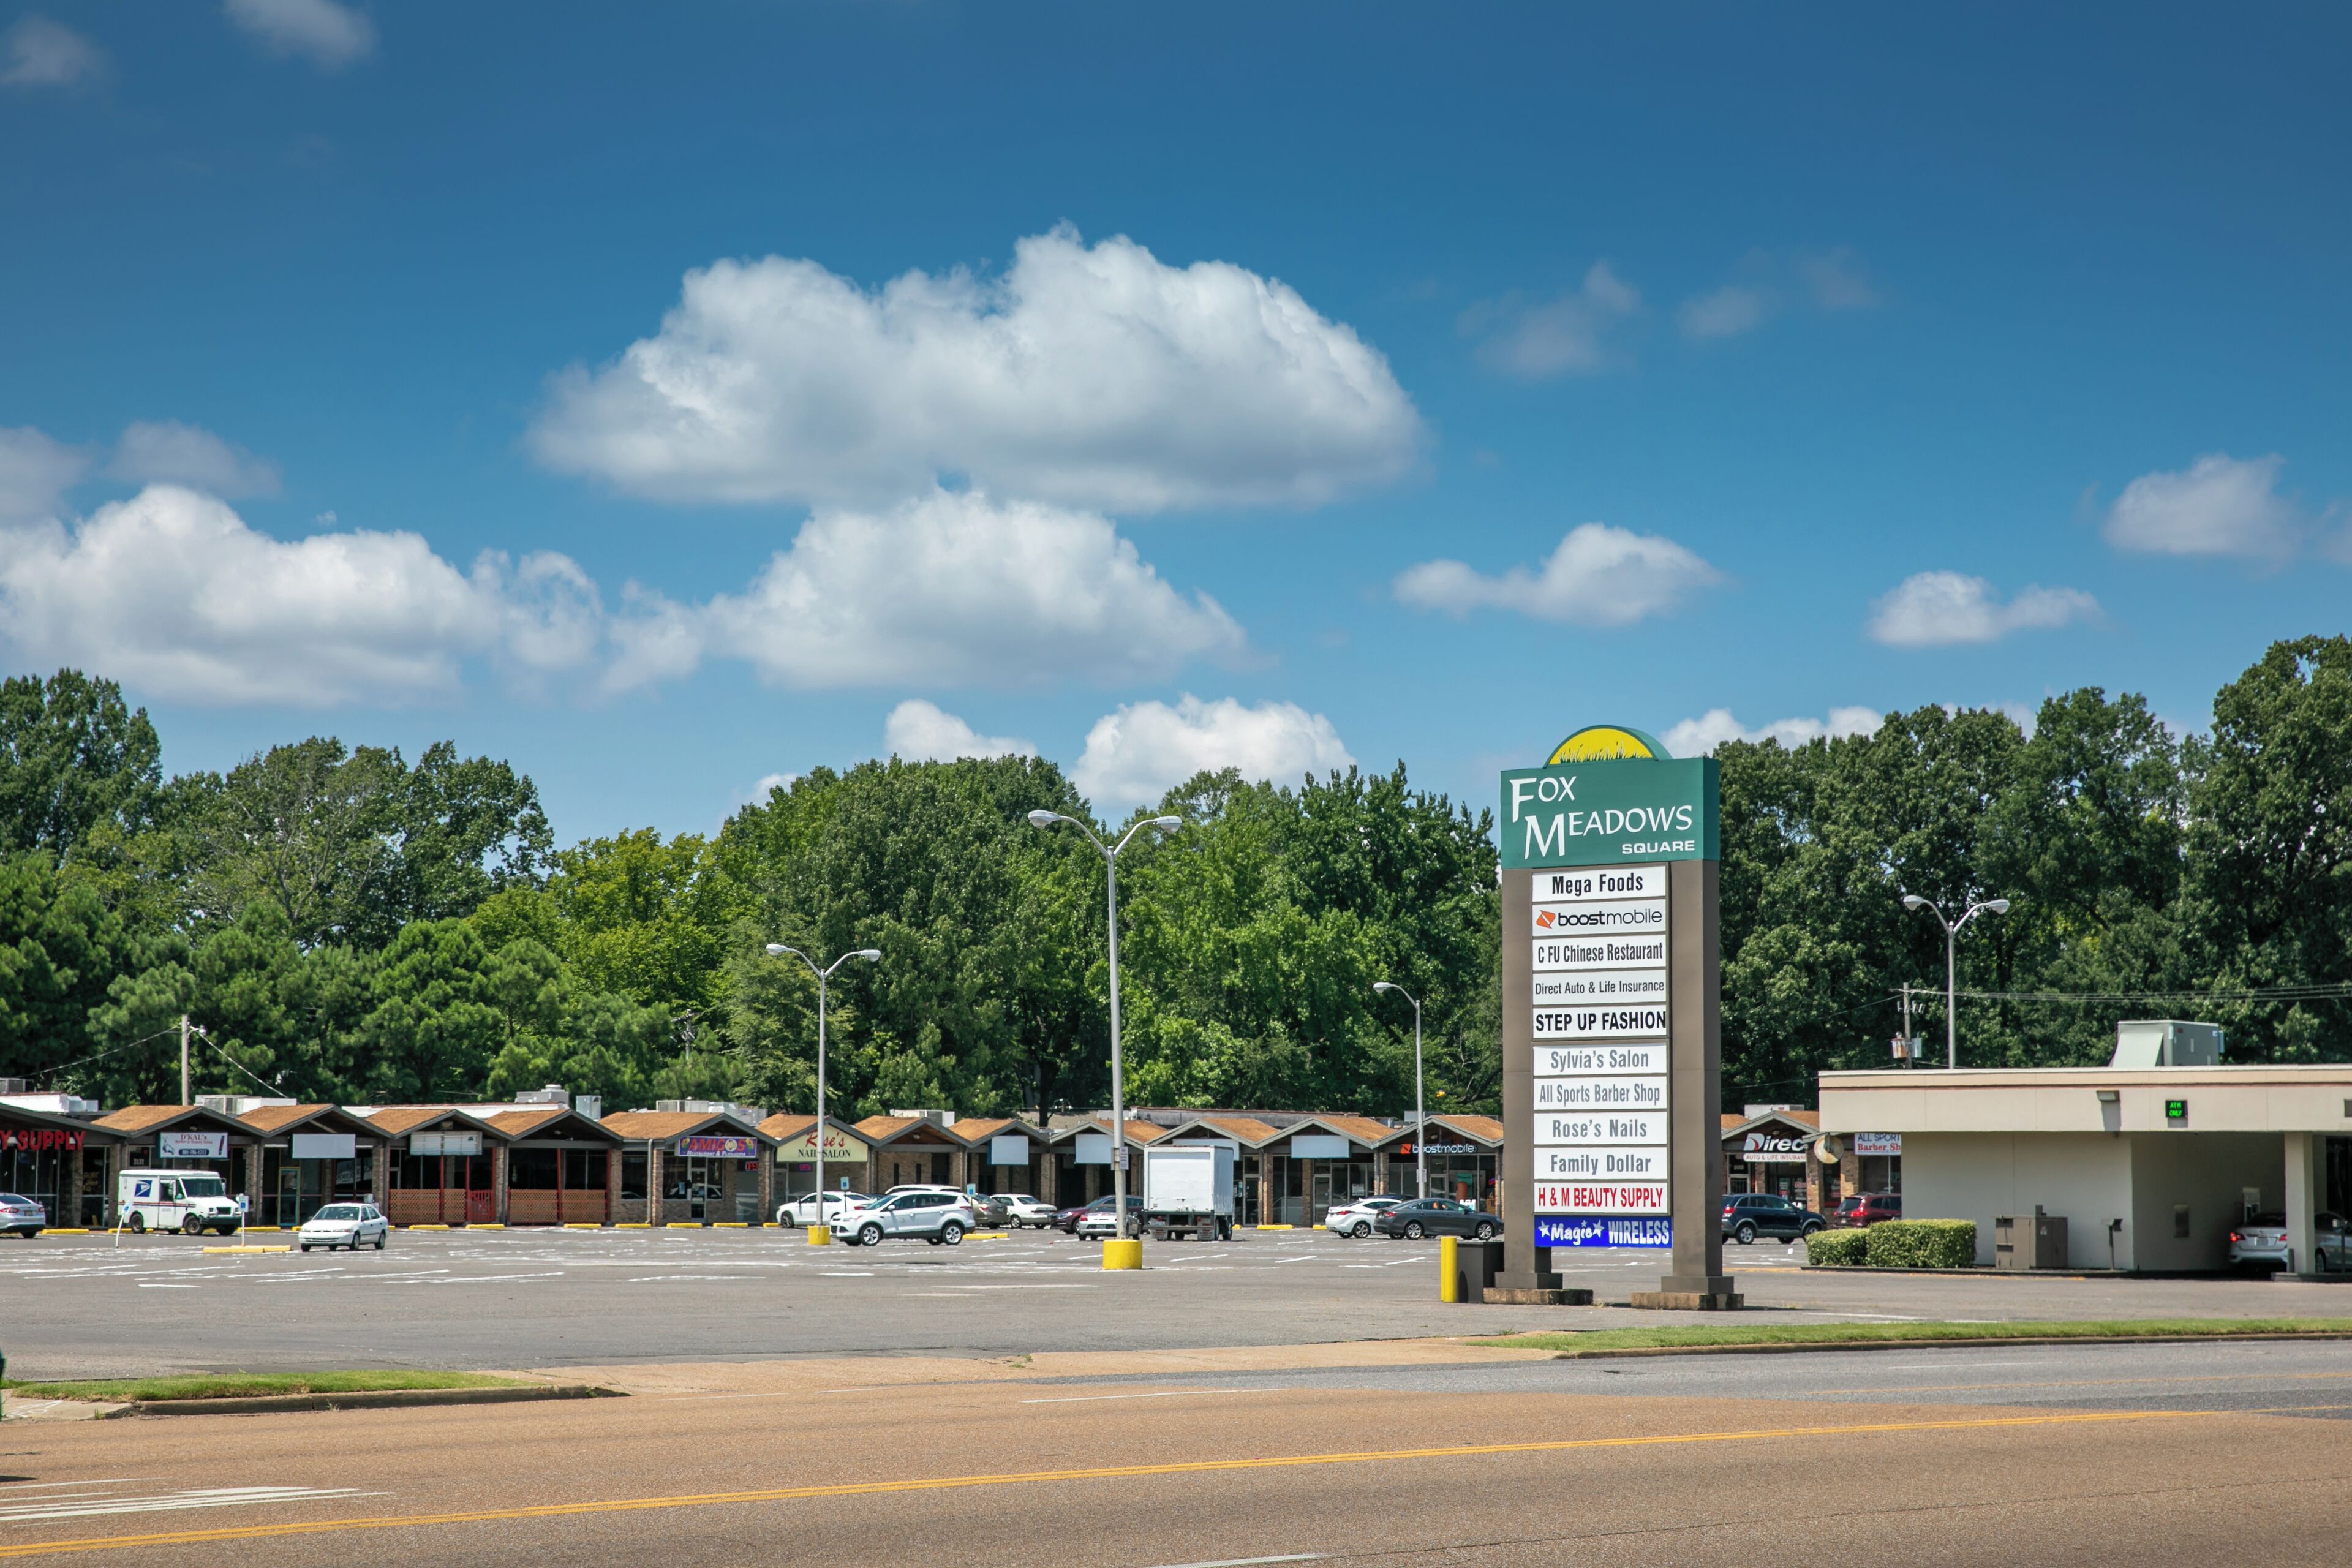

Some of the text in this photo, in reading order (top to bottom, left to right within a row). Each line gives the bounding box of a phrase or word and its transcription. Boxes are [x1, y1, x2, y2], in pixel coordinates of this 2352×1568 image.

[1509, 776, 1577, 823] FOX
[1525, 805, 1692, 860] MEADOWS
[1622, 840, 1695, 854] SQUARE
[1552, 873, 1643, 896] Mega Foods
[1558, 908, 1662, 927] boostmobile
[1538, 942, 1663, 963] C FU Chinese Restaurant
[1536, 980, 1664, 995] Direct Auto & Life Insurance
[1536, 1011, 1666, 1032] STEP UP FASHION
[1551, 1050, 1649, 1073] Sylvia's Salon
[1540, 1083, 1660, 1107] All Sports Barber Shop
[805, 1129, 845, 1147] Rse's
[1552, 1119, 1647, 1138] Rose's Nails
[1858, 1133, 1900, 1142] ALL SPORT
[17, 1130, 86, 1152] SUPPLY
[1412, 1143, 1475, 1153] bostmobile
[1743, 1133, 1806, 1152] Direc
[1551, 1154, 1651, 1175] Family Dollar
[1539, 1187, 1664, 1207] H & M BEAUTY SUPPLY
[1551, 1220, 1669, 1245] Magic WIRELESS
